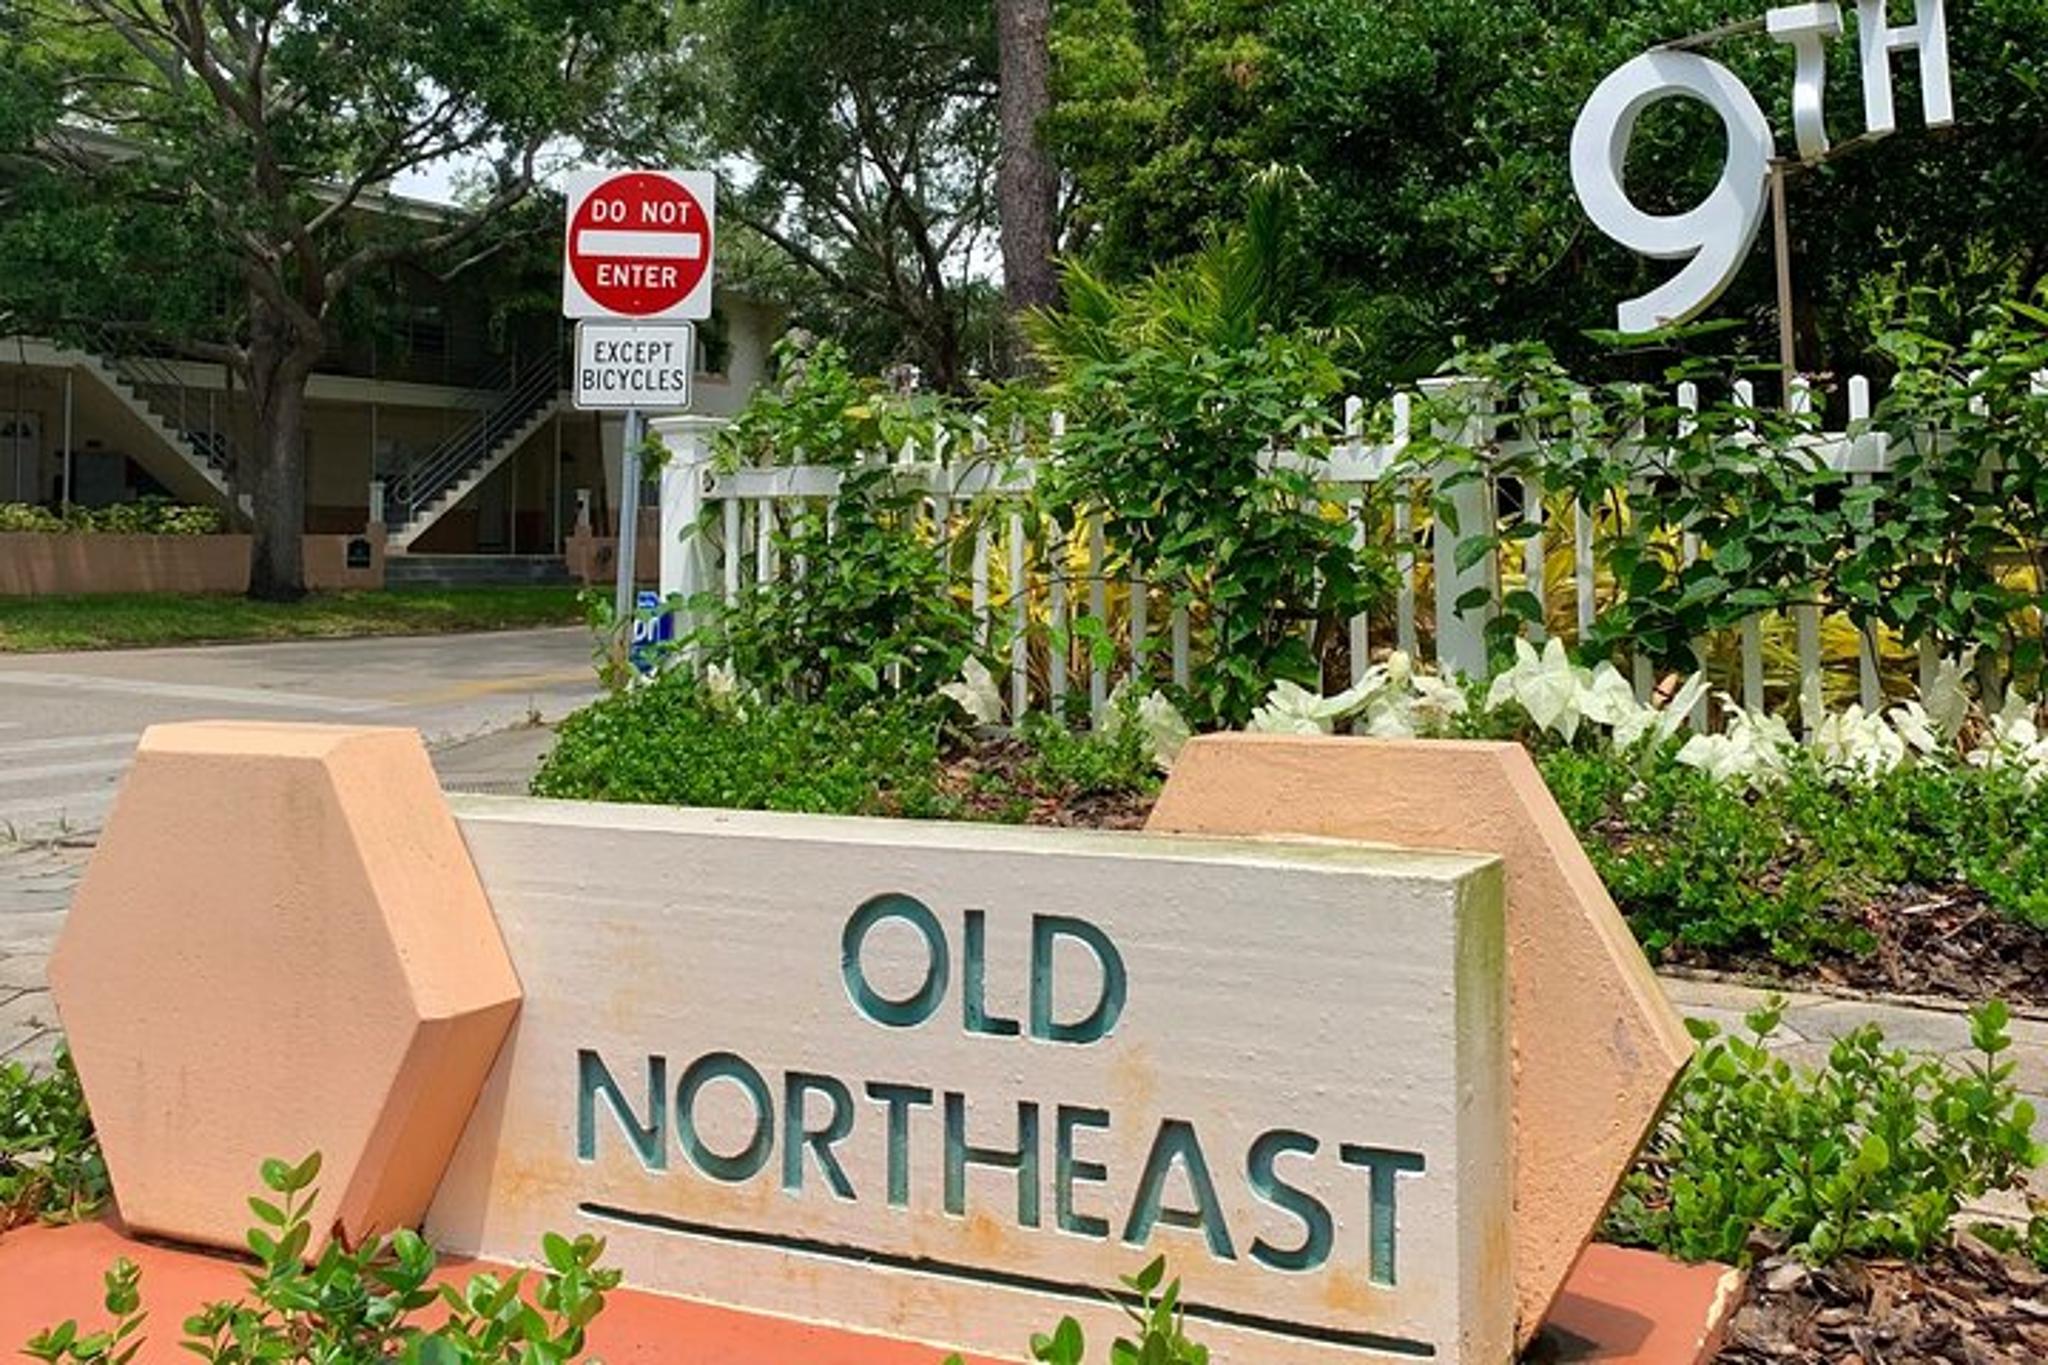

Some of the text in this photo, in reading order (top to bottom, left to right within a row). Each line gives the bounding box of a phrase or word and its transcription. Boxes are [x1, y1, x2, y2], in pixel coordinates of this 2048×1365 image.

[591, 200, 692, 224] DO NOT
[596, 263, 677, 288] ENTER
[594, 341, 673, 363] EXCEPT
[582, 369, 684, 391] BICYCLES
[841, 891, 1128, 1045] OLD
[576, 1048, 1427, 1288] NORTHEAST
